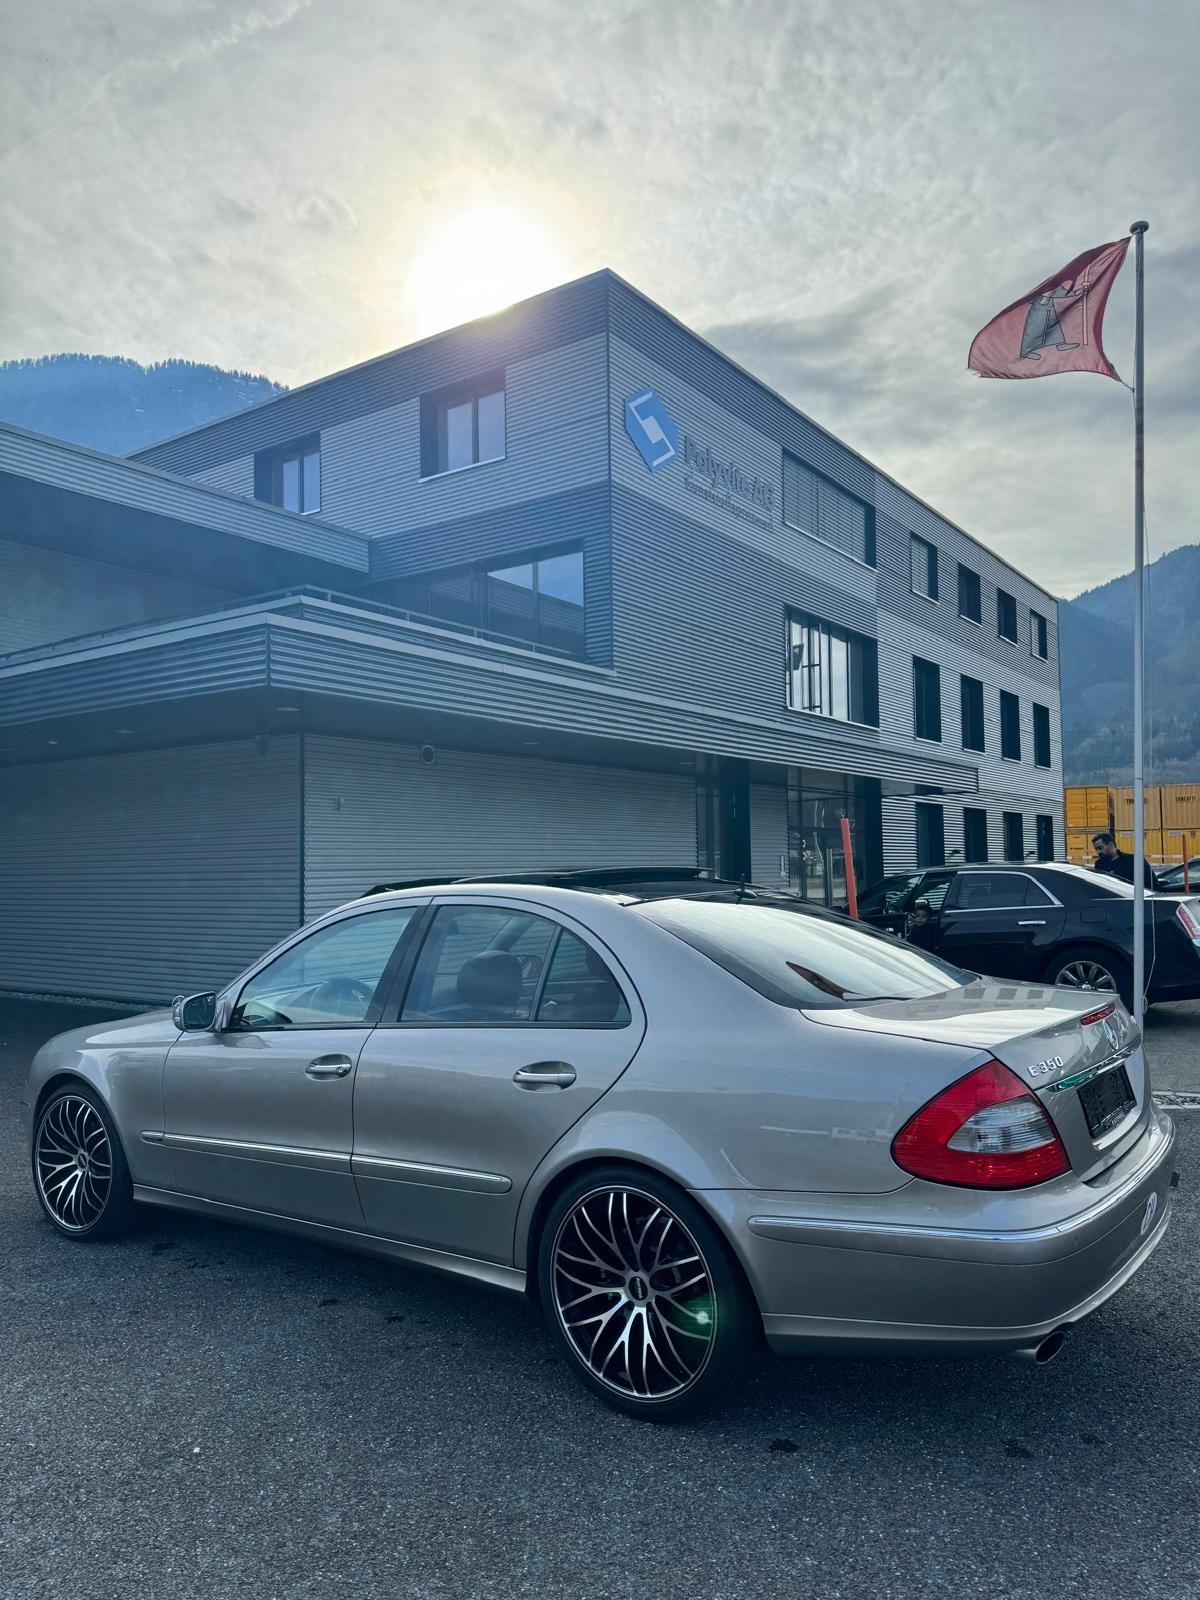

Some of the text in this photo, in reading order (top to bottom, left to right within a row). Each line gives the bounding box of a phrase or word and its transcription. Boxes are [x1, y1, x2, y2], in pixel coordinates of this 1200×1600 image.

[753, 477, 774, 508] AG
[1027, 1056, 1063, 1077] E 350
